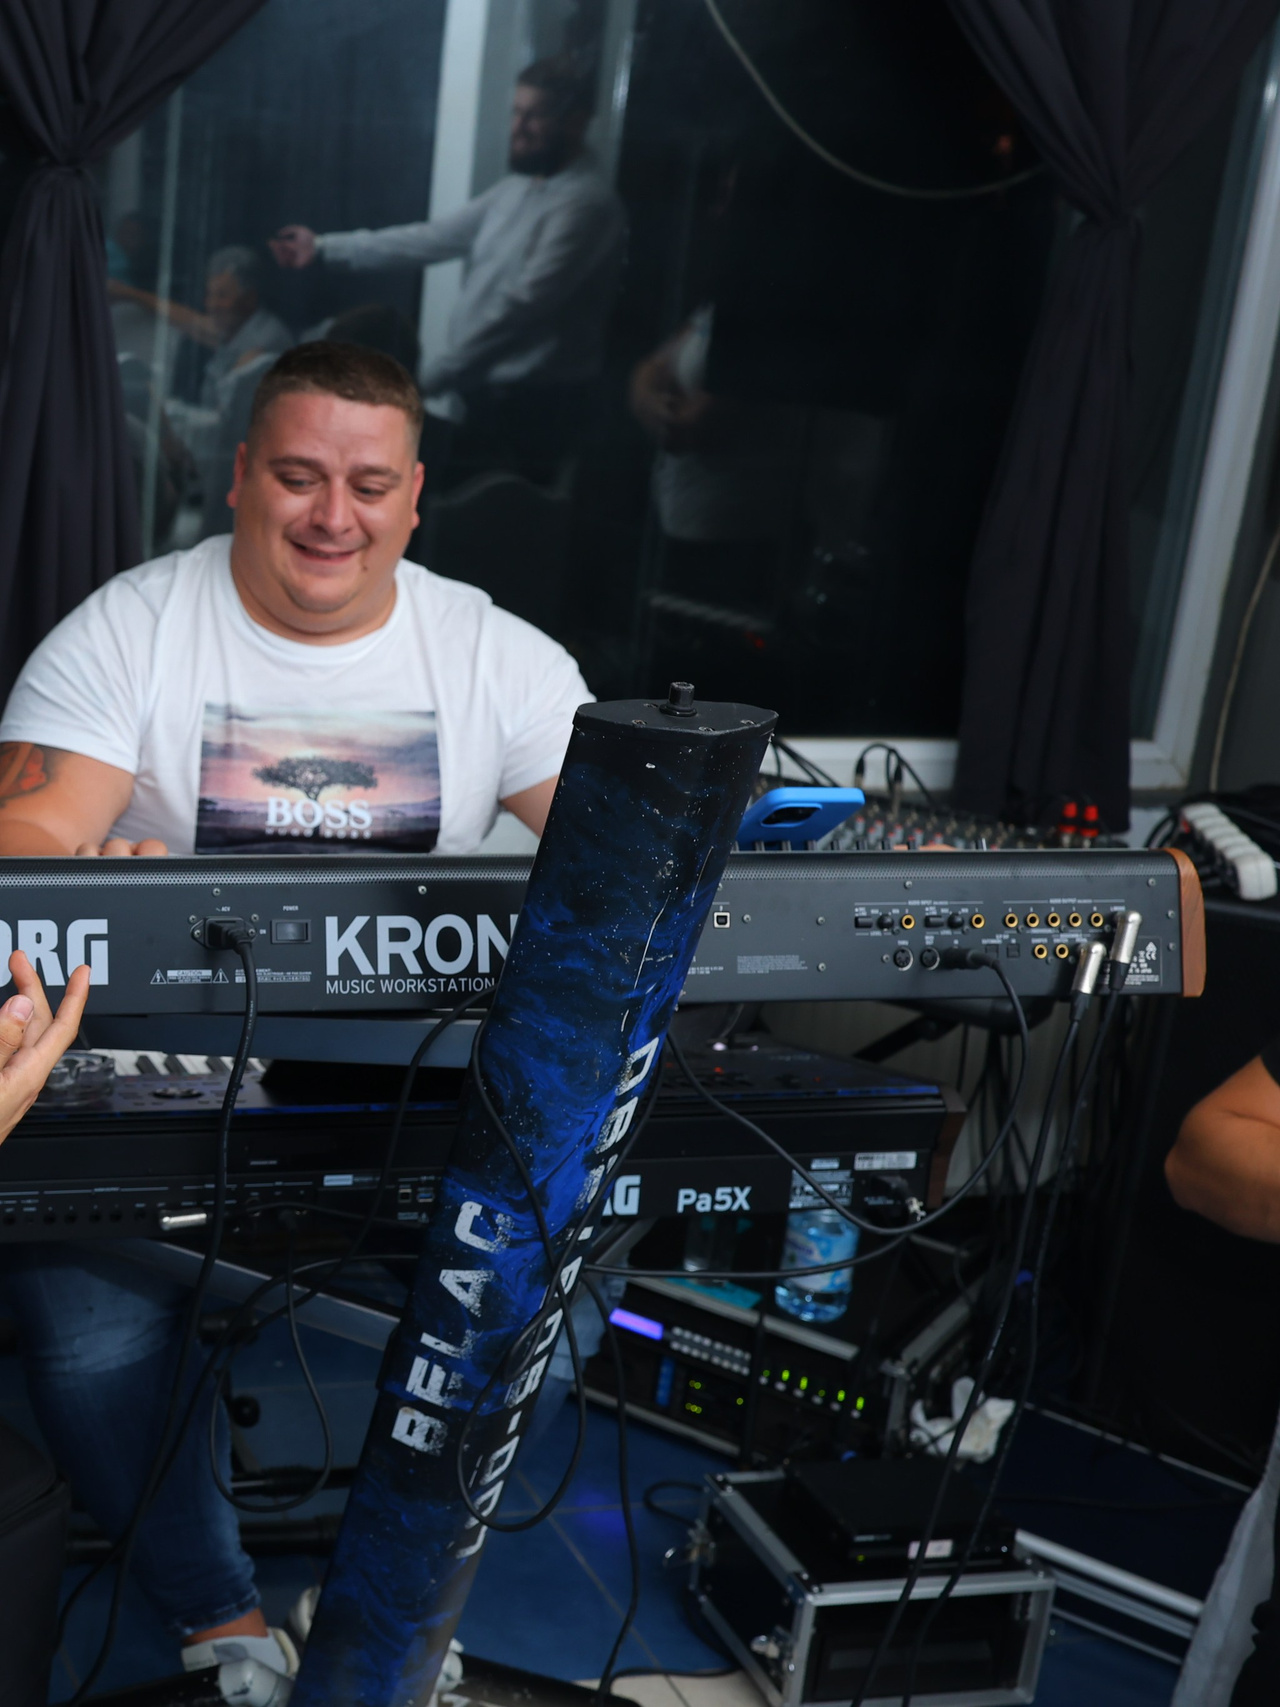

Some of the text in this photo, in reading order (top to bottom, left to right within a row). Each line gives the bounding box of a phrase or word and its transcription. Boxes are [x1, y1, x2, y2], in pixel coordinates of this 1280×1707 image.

[266, 796, 373, 830] BOSS
[265, 827, 373, 840] HUGO BOSS
[326, 977, 496, 995] MUSIC WORKSTATION
[676, 1185, 753, 1214] Pa5X
